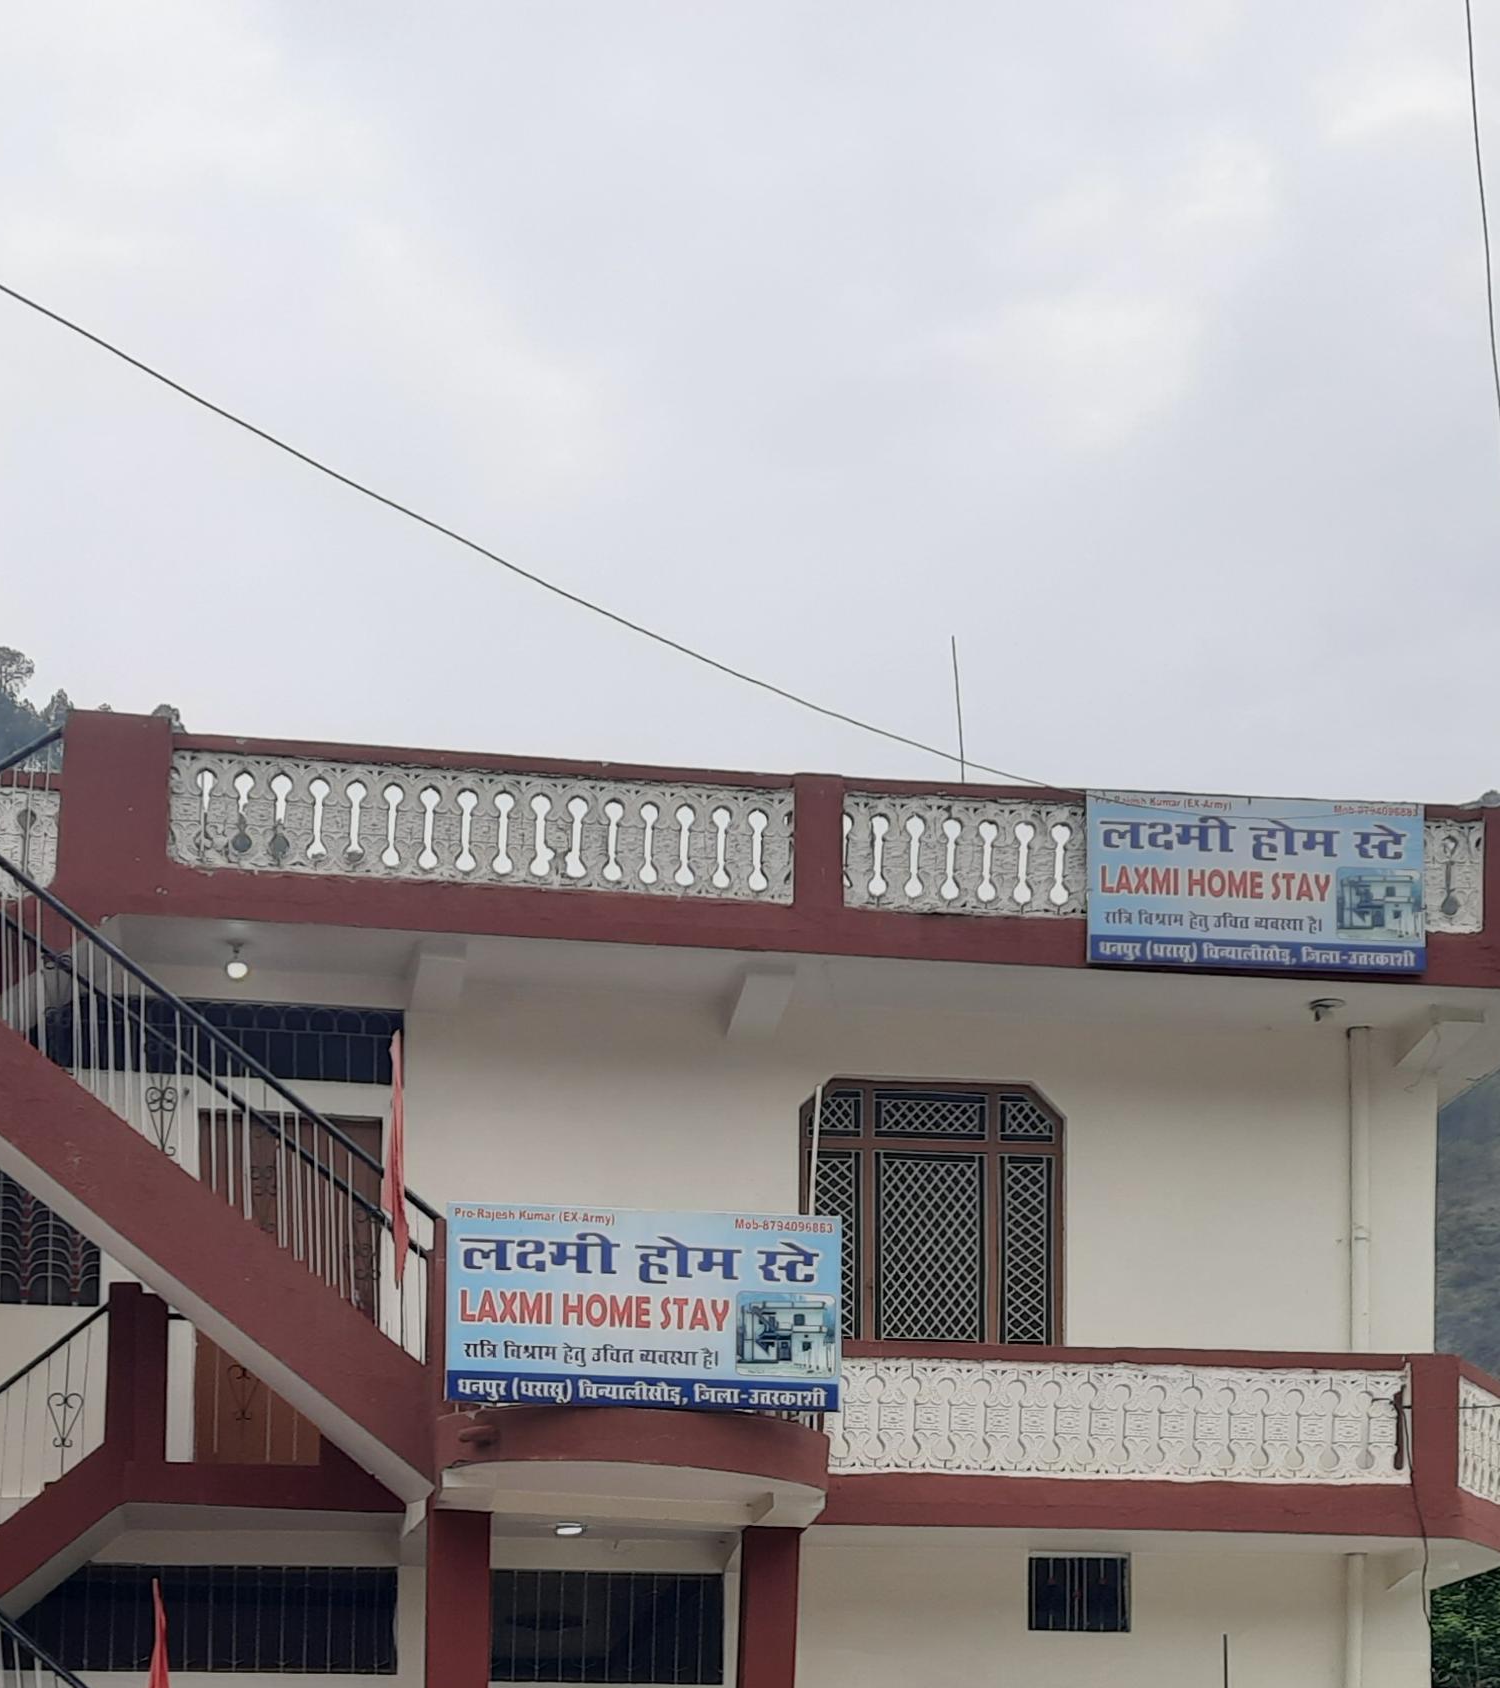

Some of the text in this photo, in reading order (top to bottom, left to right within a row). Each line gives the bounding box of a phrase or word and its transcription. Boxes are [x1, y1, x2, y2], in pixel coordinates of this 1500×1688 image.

[1248, 818, 1341, 861] होम
[1353, 824, 1407, 860] स्टे
[1100, 864, 1331, 902] LAXMI HOME STAY
[454, 1207, 515, 1221] Pro-Rajesh
[518, 1208, 556, 1222] Kumar
[635, 1235, 742, 1284] होम
[757, 1241, 819, 1283] स्टे
[459, 1289, 730, 1332] LAXMI HOME STAY
[463, 1339, 497, 1359] रात्रि
[562, 1342, 587, 1367] हेतु
[592, 1343, 634, 1363] उचित
